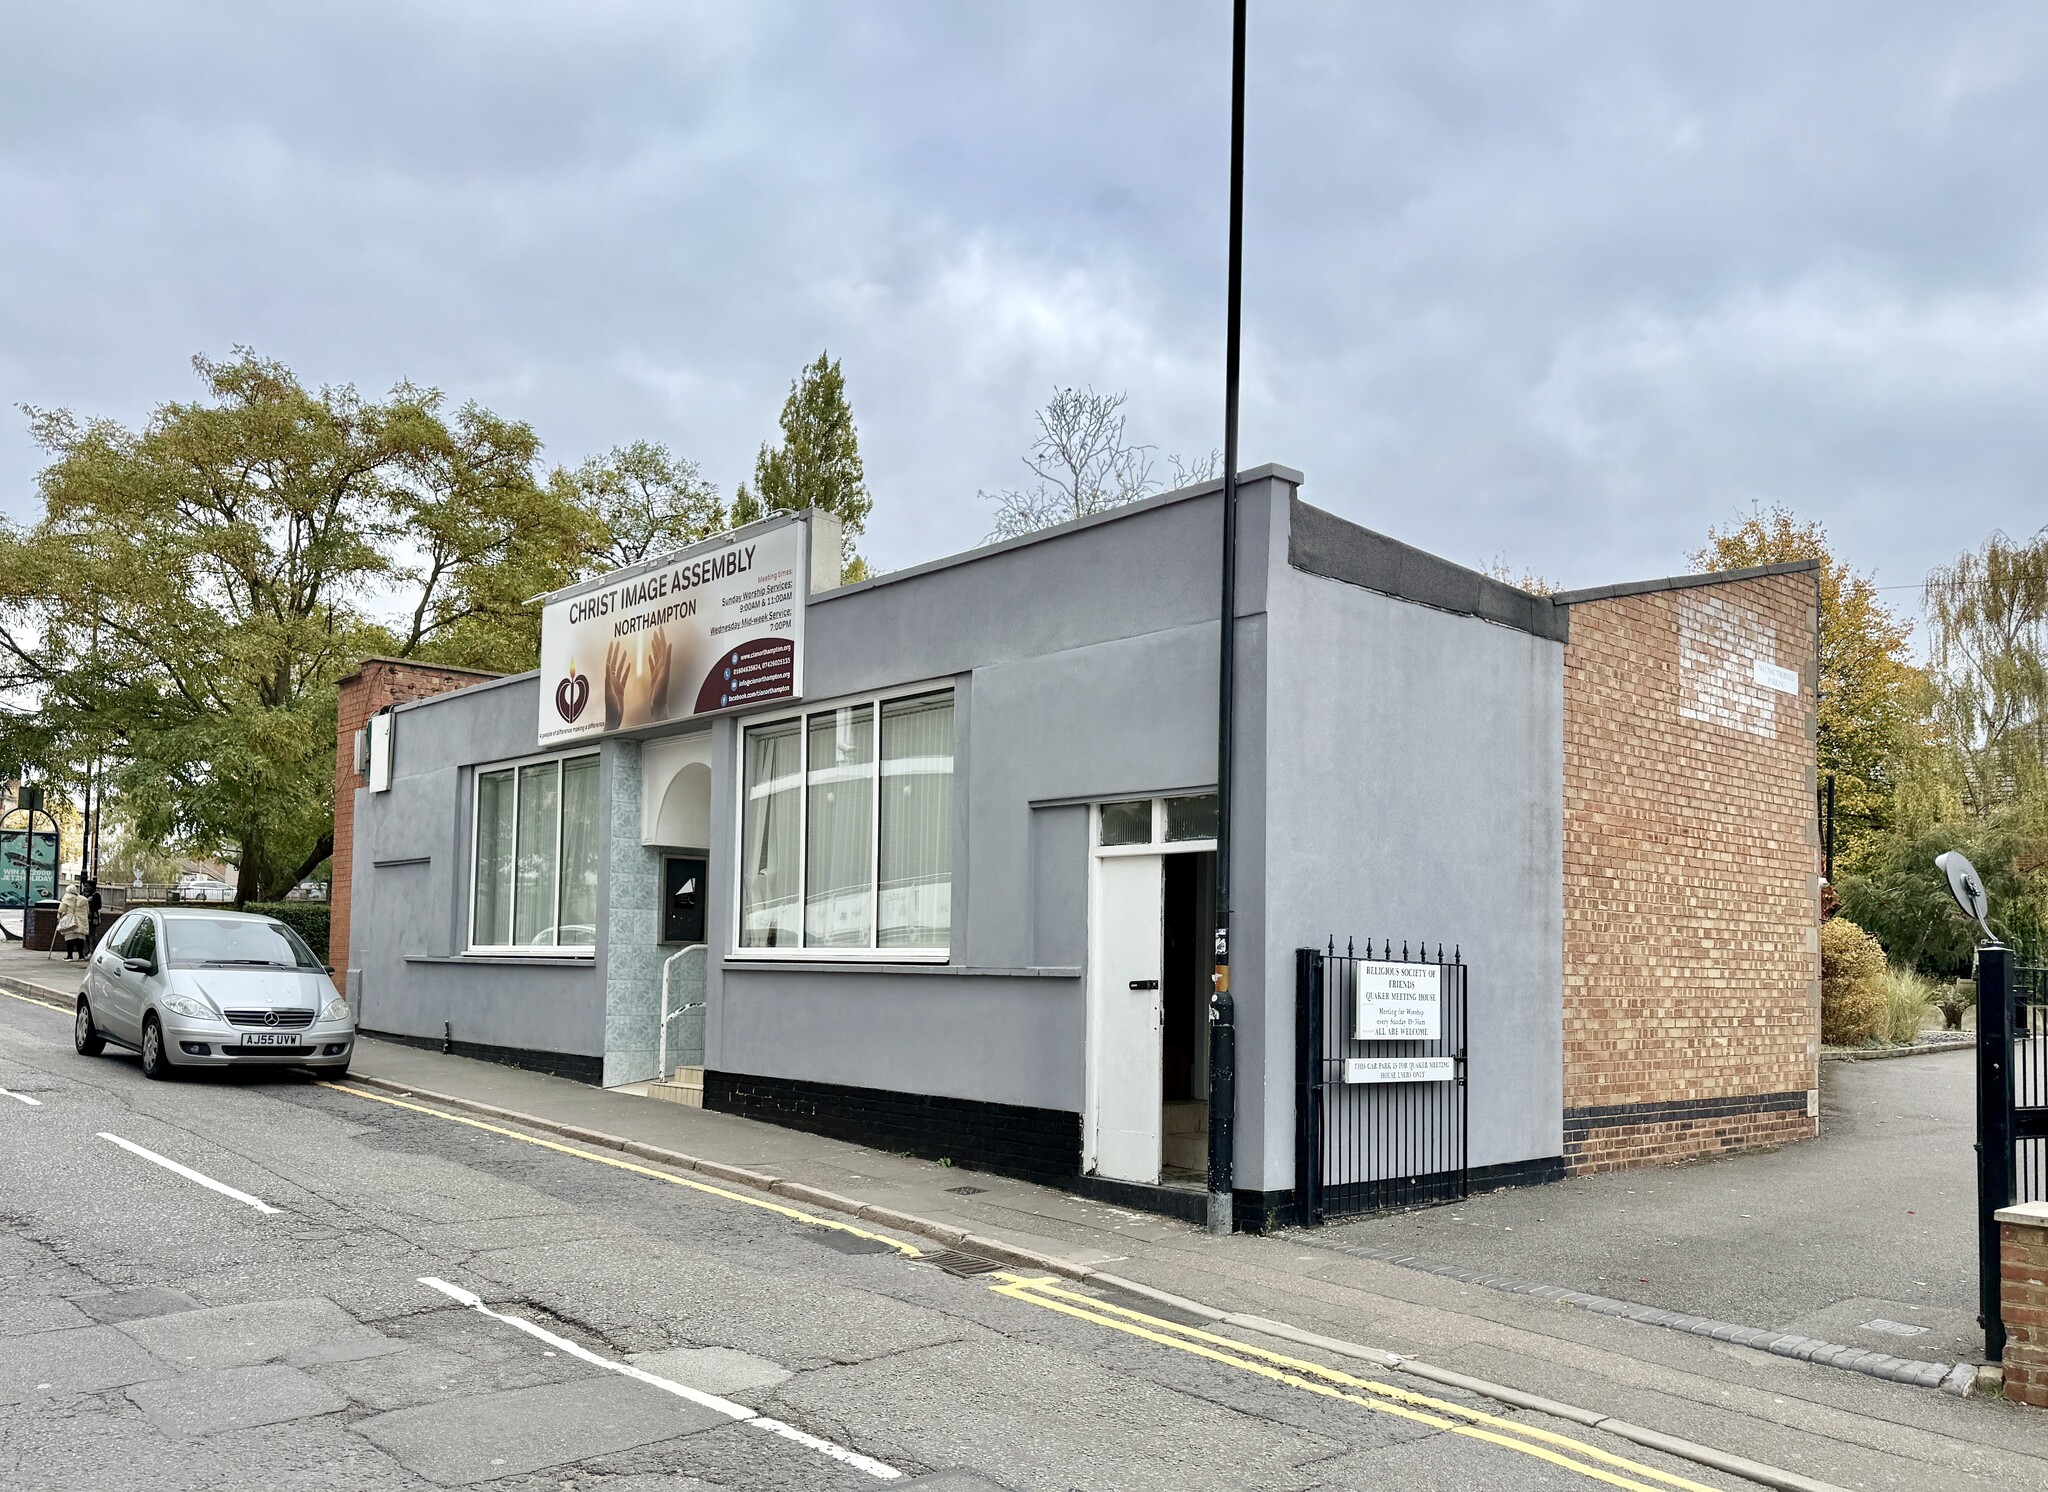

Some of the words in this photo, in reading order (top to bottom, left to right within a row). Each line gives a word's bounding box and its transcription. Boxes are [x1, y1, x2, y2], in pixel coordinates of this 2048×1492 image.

[758, 572, 777, 584] Meeting
[778, 569, 793, 578] times:
[570, 590, 617, 624] CHRIST
[621, 574, 668, 609] IMAGE
[671, 545, 756, 594] ASSEMBLY
[722, 594, 742, 607] Sunday
[743, 587, 766, 601] Worship
[767, 581, 793, 593] Services:
[740, 601, 760, 613] 9:00AM
[761, 599, 766, 607] &
[768, 591, 793, 606] 11:00AM
[614, 599, 697, 637] NORTHAMPTON
[710, 622, 741, 636] Wednesday
[741, 613, 768, 627] Mid-week
[769, 609, 792, 620] Service:
[770, 620, 792, 632] 7:00PM
[1, 874, 53, 882] JET2HLIDAY
[29, 869, 51, 877] 2000
[1366, 966, 1399, 976] RELIGIOUS
[1401, 968, 1427, 977] SOCIETY
[1428, 970, 1436, 978] OF
[1388, 980, 1415, 989] FRIENDS
[1366, 992, 1390, 1001] QUAKER
[1391, 992, 1416, 1001] MEETING
[1418, 993, 1436, 1001] HOUSE
[1379, 1007, 1397, 1017] Meeting
[1406, 1008, 1424, 1017] Worship
[1390, 1018, 1406, 1027] Sunday
[1375, 1028, 1386, 1036] ALL
[1388, 1028, 1399, 1036] ARE
[1400, 1028, 1428, 1036] WELCOME
[247, 1034, 274, 1044] AJ55
[277, 1035, 297, 1044] UVW
[1378, 1062, 1391, 1070] PARK
[1409, 1062, 1428, 1070] QUAKER
[1429, 1061, 1450, 1069] MEETING
